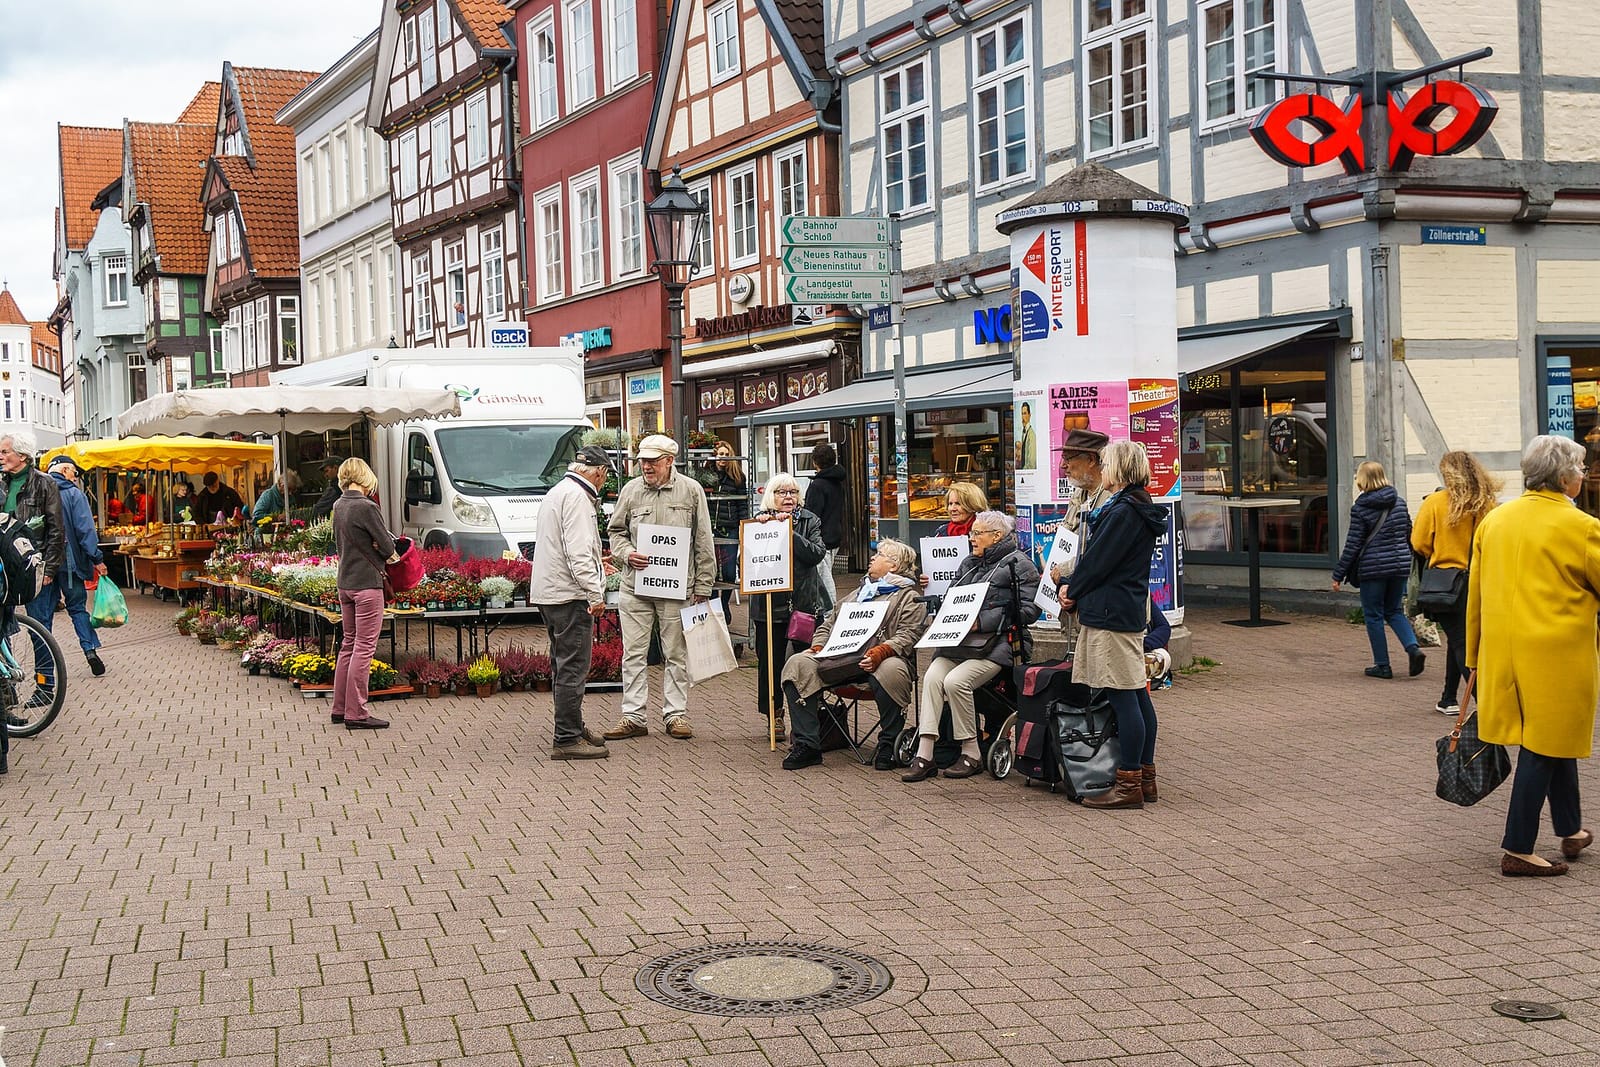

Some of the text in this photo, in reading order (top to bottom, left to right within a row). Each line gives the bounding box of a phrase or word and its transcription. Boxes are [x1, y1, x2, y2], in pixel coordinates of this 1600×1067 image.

[1039, 206, 1047, 214] 30
[1062, 201, 1081, 212] 103
[803, 221, 838, 230] Bahnhof
[803, 233, 832, 241] Schloß
[1429, 229, 1479, 241] Zöllnerstraße
[803, 251, 830, 259] Neues
[833, 251, 867, 259] Rathaus
[803, 262, 862, 270] Bieneninstitut
[1050, 229, 1063, 317] INTERSPORT
[1064, 258, 1072, 287] CELLE
[806, 280, 853, 290] Landgestüt
[807, 291, 849, 299] Französischer
[851, 291, 872, 299] Garten
[873, 310, 889, 326] Markt
[974, 303, 1013, 345] NO
[492, 330, 526, 343] back
[1051, 386, 1098, 399] LADIES
[1132, 390, 1164, 402] Theater
[1061, 398, 1098, 410] NIGHT
[651, 535, 677, 546] OPAS
[754, 531, 779, 541] OMAS
[1058, 538, 1073, 554] OPAS
[932, 547, 958, 559] OMAS
[648, 556, 678, 567] GEGEN
[752, 554, 782, 564] GEGEN
[643, 577, 680, 589] RECHTS
[750, 578, 784, 588] RECHTS
[952, 593, 976, 605] OMAS
[849, 610, 875, 620] OMAS
[942, 613, 970, 624] GEGEN
[840, 628, 868, 638] GEGEN
[928, 631, 961, 641] RECHTS
